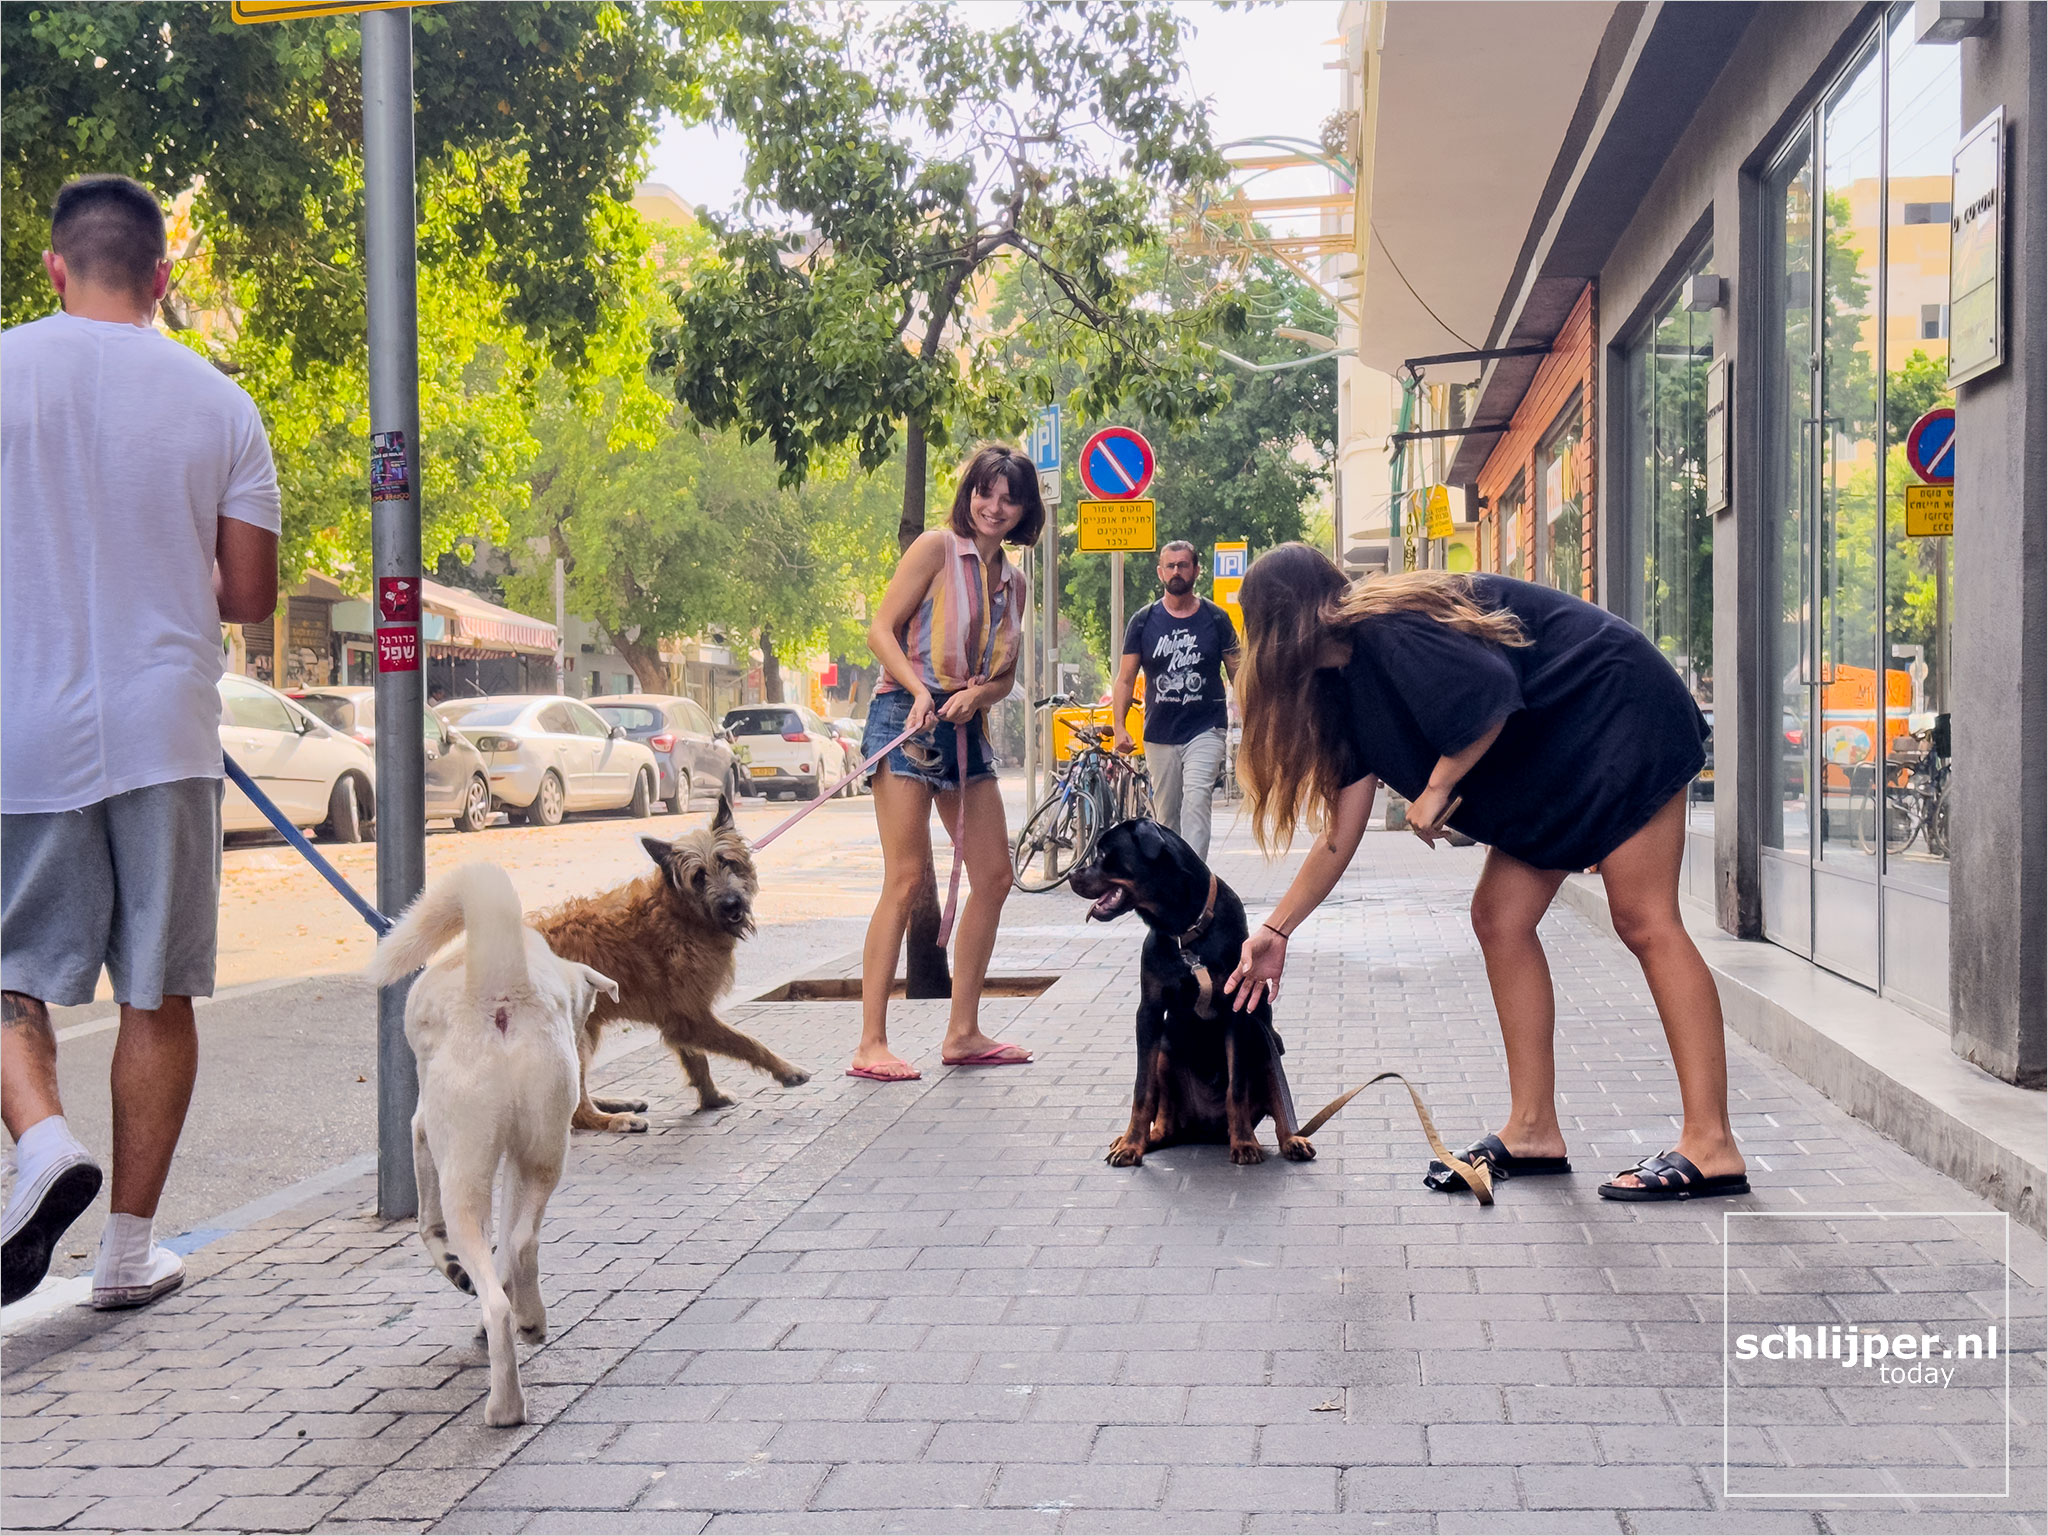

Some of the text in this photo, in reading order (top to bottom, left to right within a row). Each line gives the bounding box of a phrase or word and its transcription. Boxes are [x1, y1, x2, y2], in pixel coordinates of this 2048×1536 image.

[1092, 505, 1142, 513] מקום שמור
[1083, 515, 1151, 524] לחניית אופניים
[1097, 527, 1137, 535] וקורקינט
[1106, 538, 1128, 546] בלבד
[380, 634, 415, 645] כדורגל
